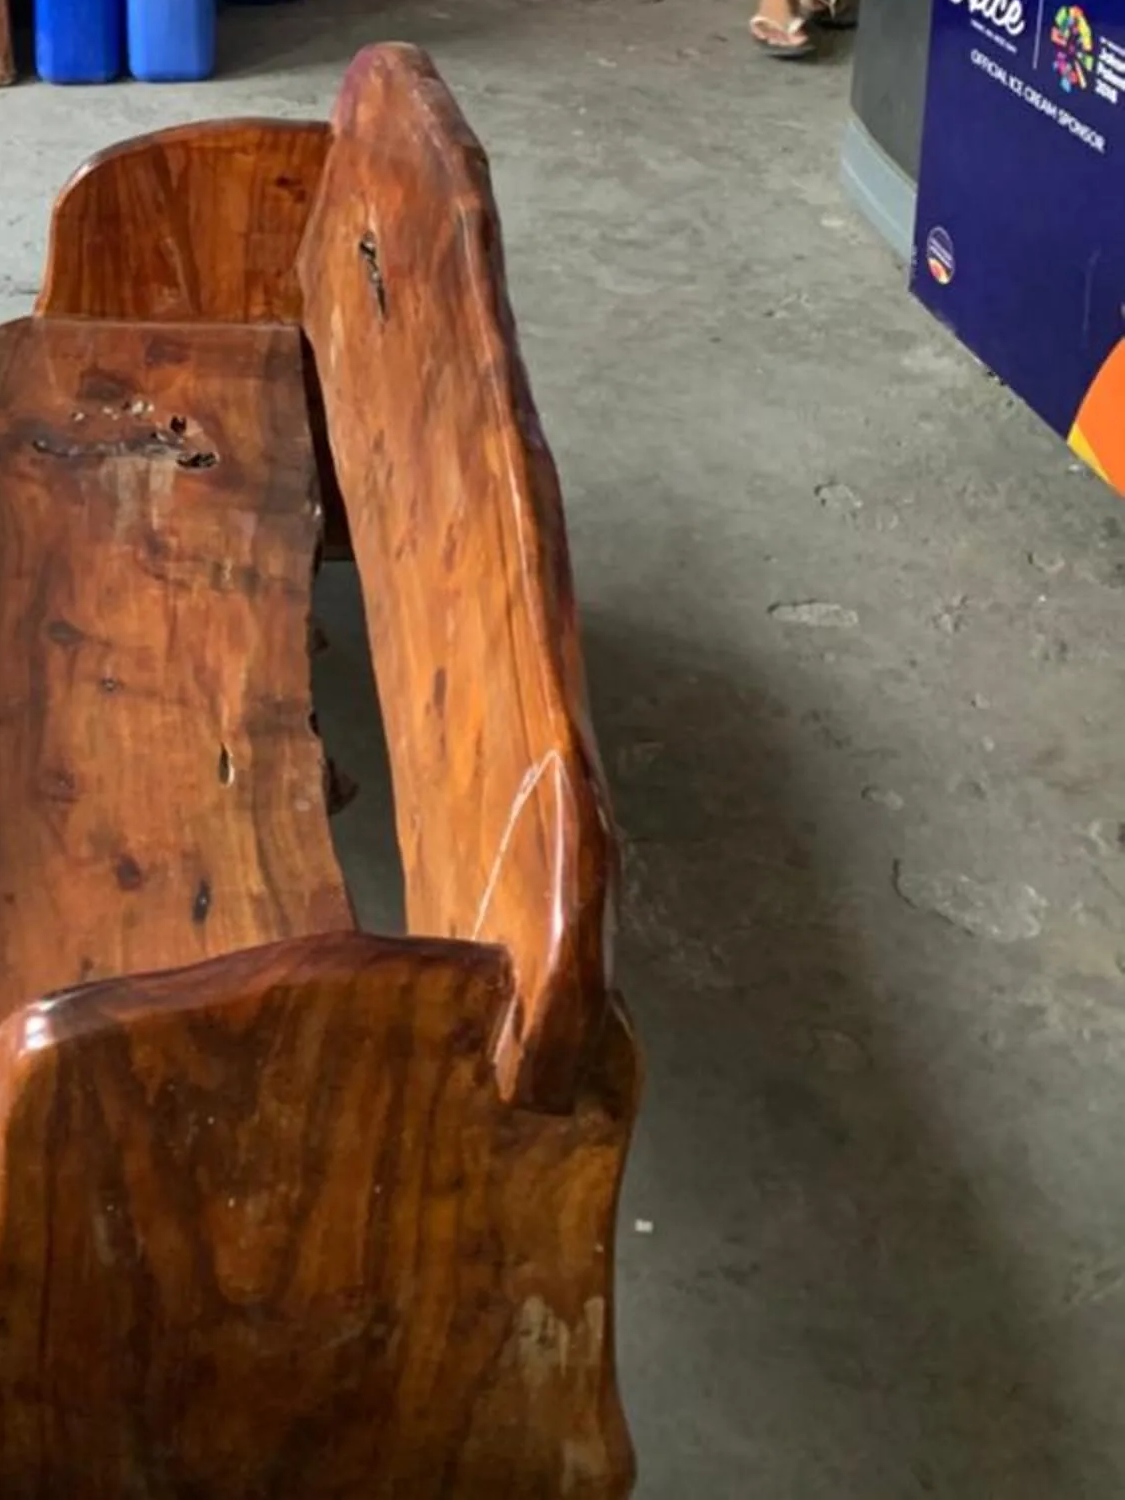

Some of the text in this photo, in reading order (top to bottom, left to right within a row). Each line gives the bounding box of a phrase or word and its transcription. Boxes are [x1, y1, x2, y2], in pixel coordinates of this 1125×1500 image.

[970, 48, 1106, 155] OFFICIAL ICE CREAM SPONSOR
